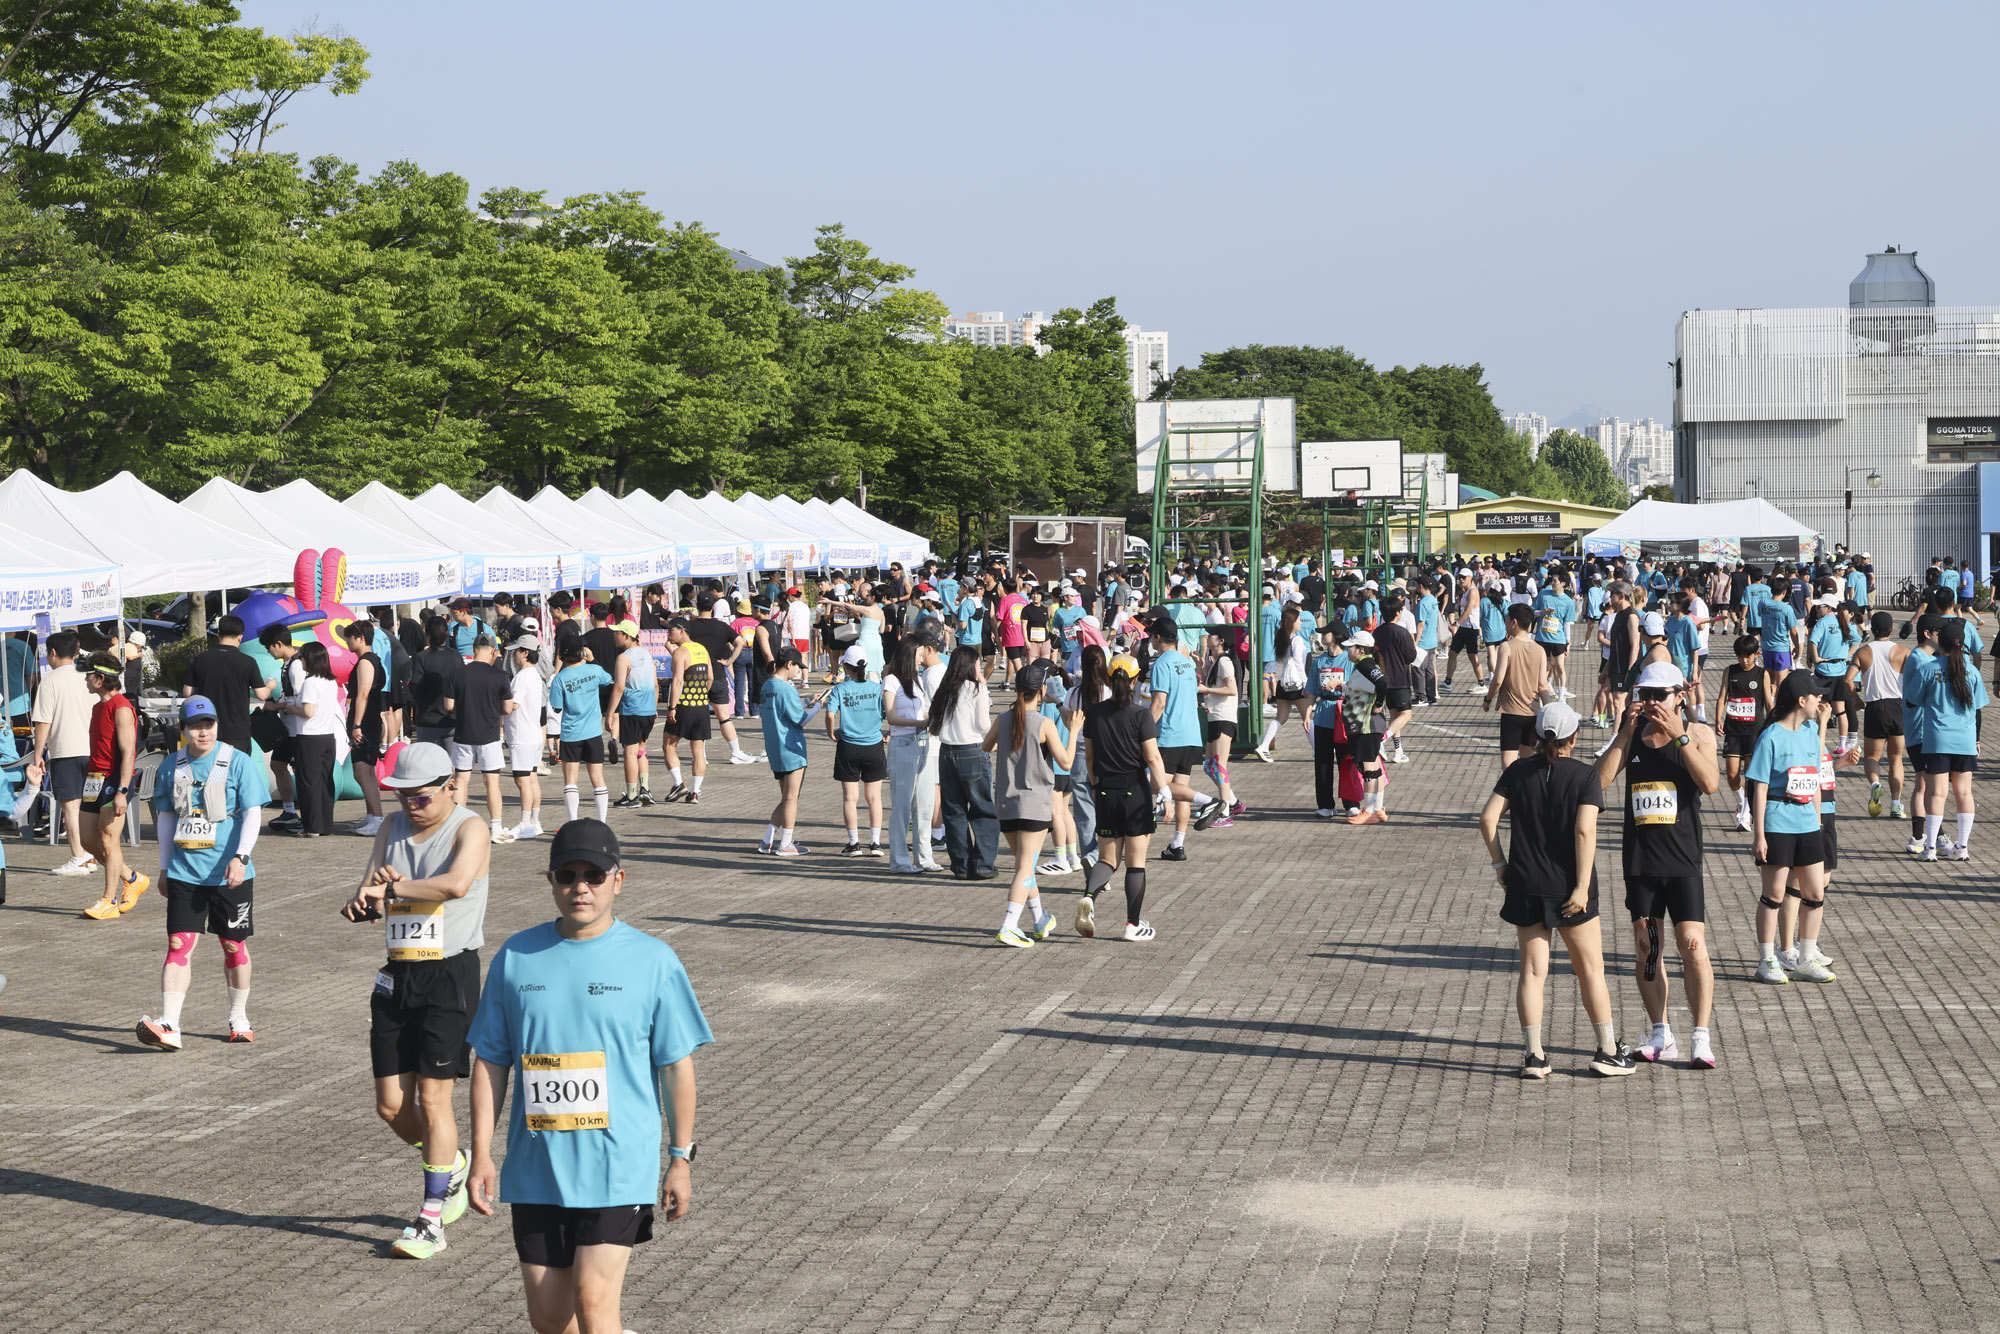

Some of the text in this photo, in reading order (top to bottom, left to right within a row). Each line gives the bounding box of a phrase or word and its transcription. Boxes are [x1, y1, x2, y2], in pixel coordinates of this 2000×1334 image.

[1936, 425, 1993, 434] GGOMA TRUCK
[1505, 514, 1553, 524] 자전거 매표소
[400, 571, 419, 588] 무료체험
[508, 567, 525, 583] 시작하는
[20, 588, 46, 611] 스트레스
[46, 588, 60, 610] 검사
[60, 586, 73, 609] 체험
[1729, 704, 1753, 713] 5013
[1790, 778, 1818, 791] 5659
[1635, 795, 1673, 811] 1048
[237, 901, 249, 929] NIKE
[389, 922, 438, 940] 1124
[530, 1078, 600, 1104] 1300
[574, 1116, 604, 1126] 10 km
